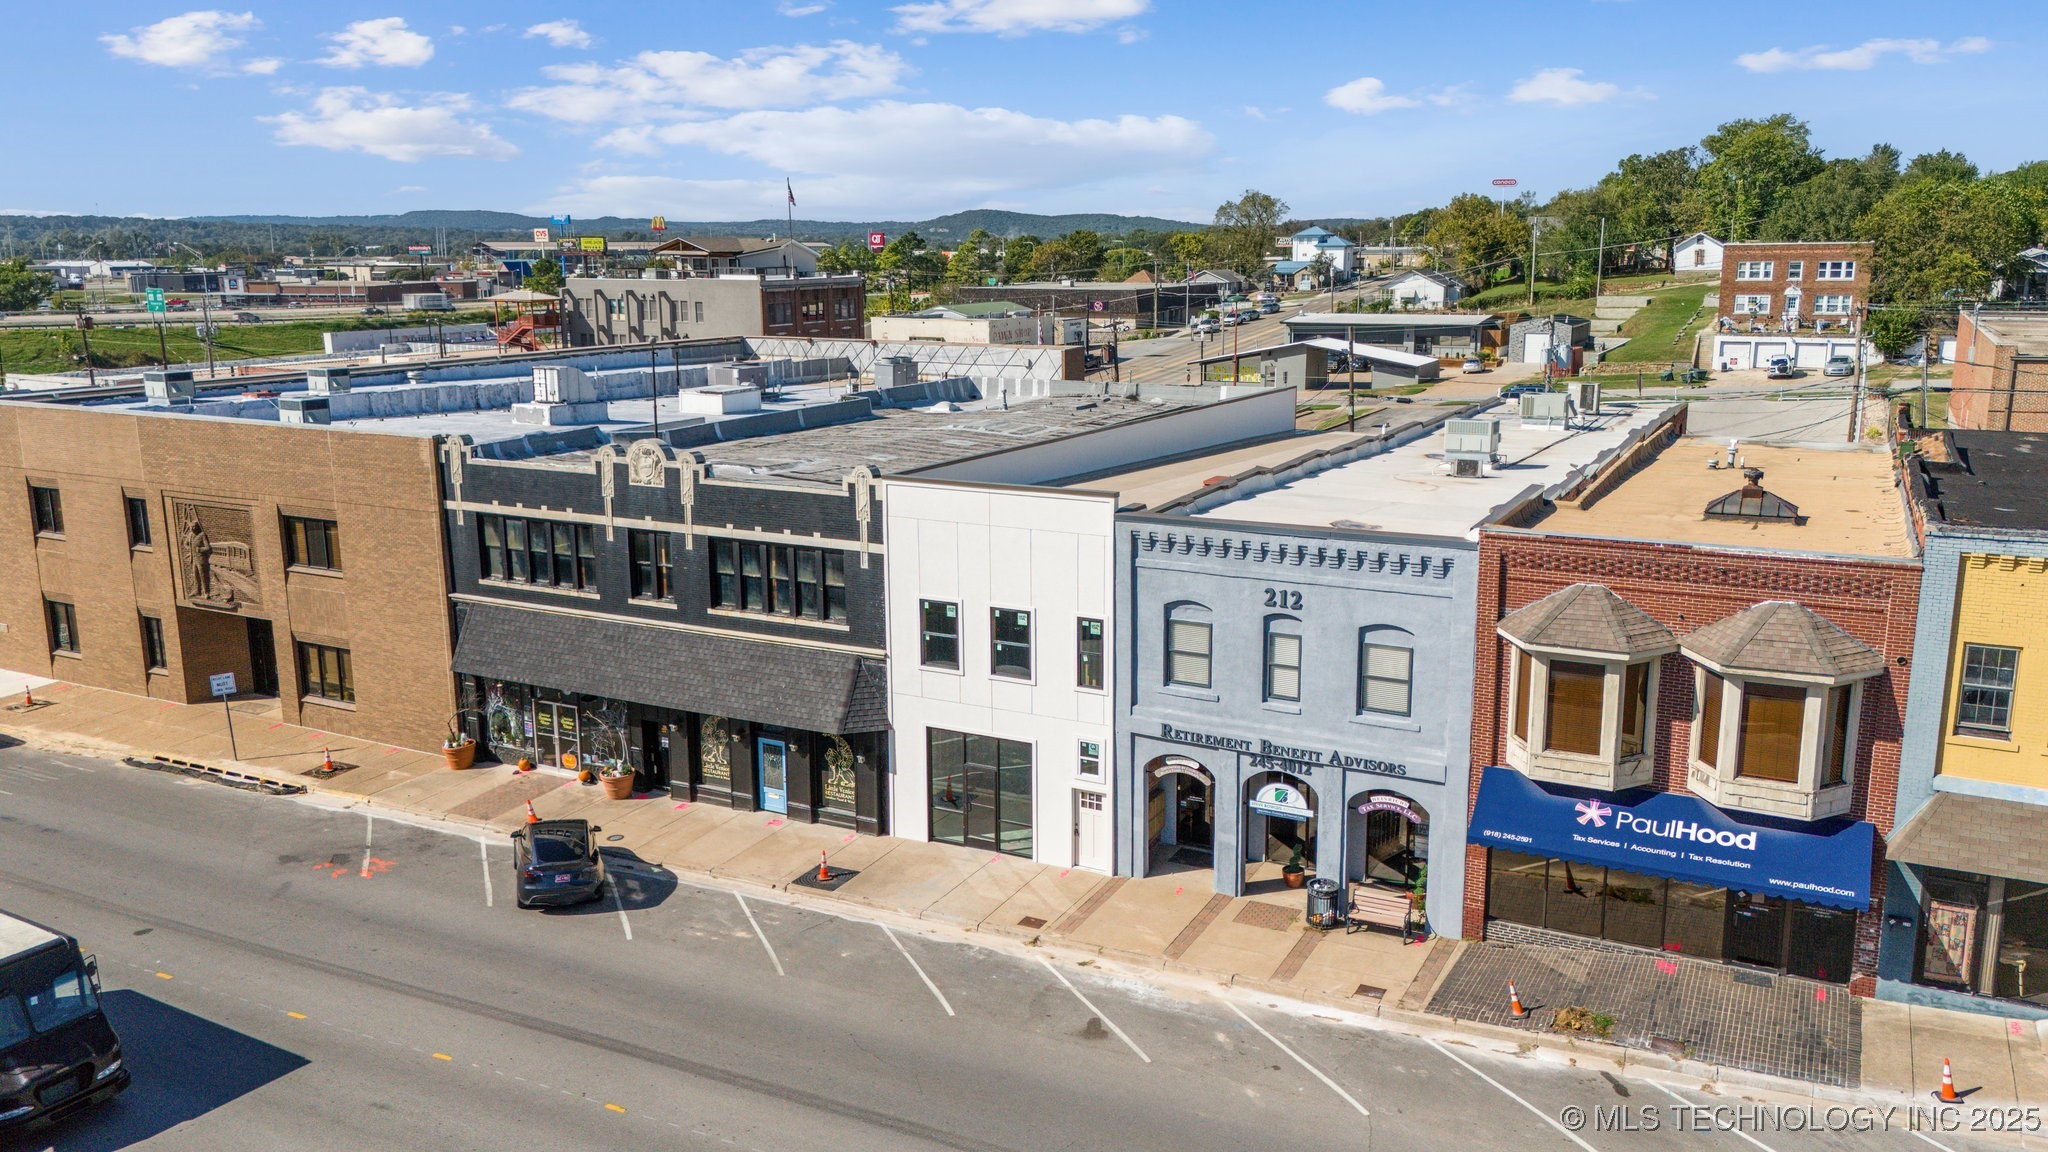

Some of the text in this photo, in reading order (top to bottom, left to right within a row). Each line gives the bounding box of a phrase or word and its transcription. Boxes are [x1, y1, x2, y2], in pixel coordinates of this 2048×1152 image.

[871, 234, 882, 243] QT
[1264, 588, 1303, 610] 212
[1249, 754, 1313, 777] 245-4012
[1404, 808, 1418, 820] LLC
[1483, 830, 1501, 839] (918)
[1615, 811, 1757, 851] PaulHood
[1572, 834, 1751, 869] Tax Services Accounting Tax Resolution
[1768, 878, 1856, 897] www.paulhood.com
